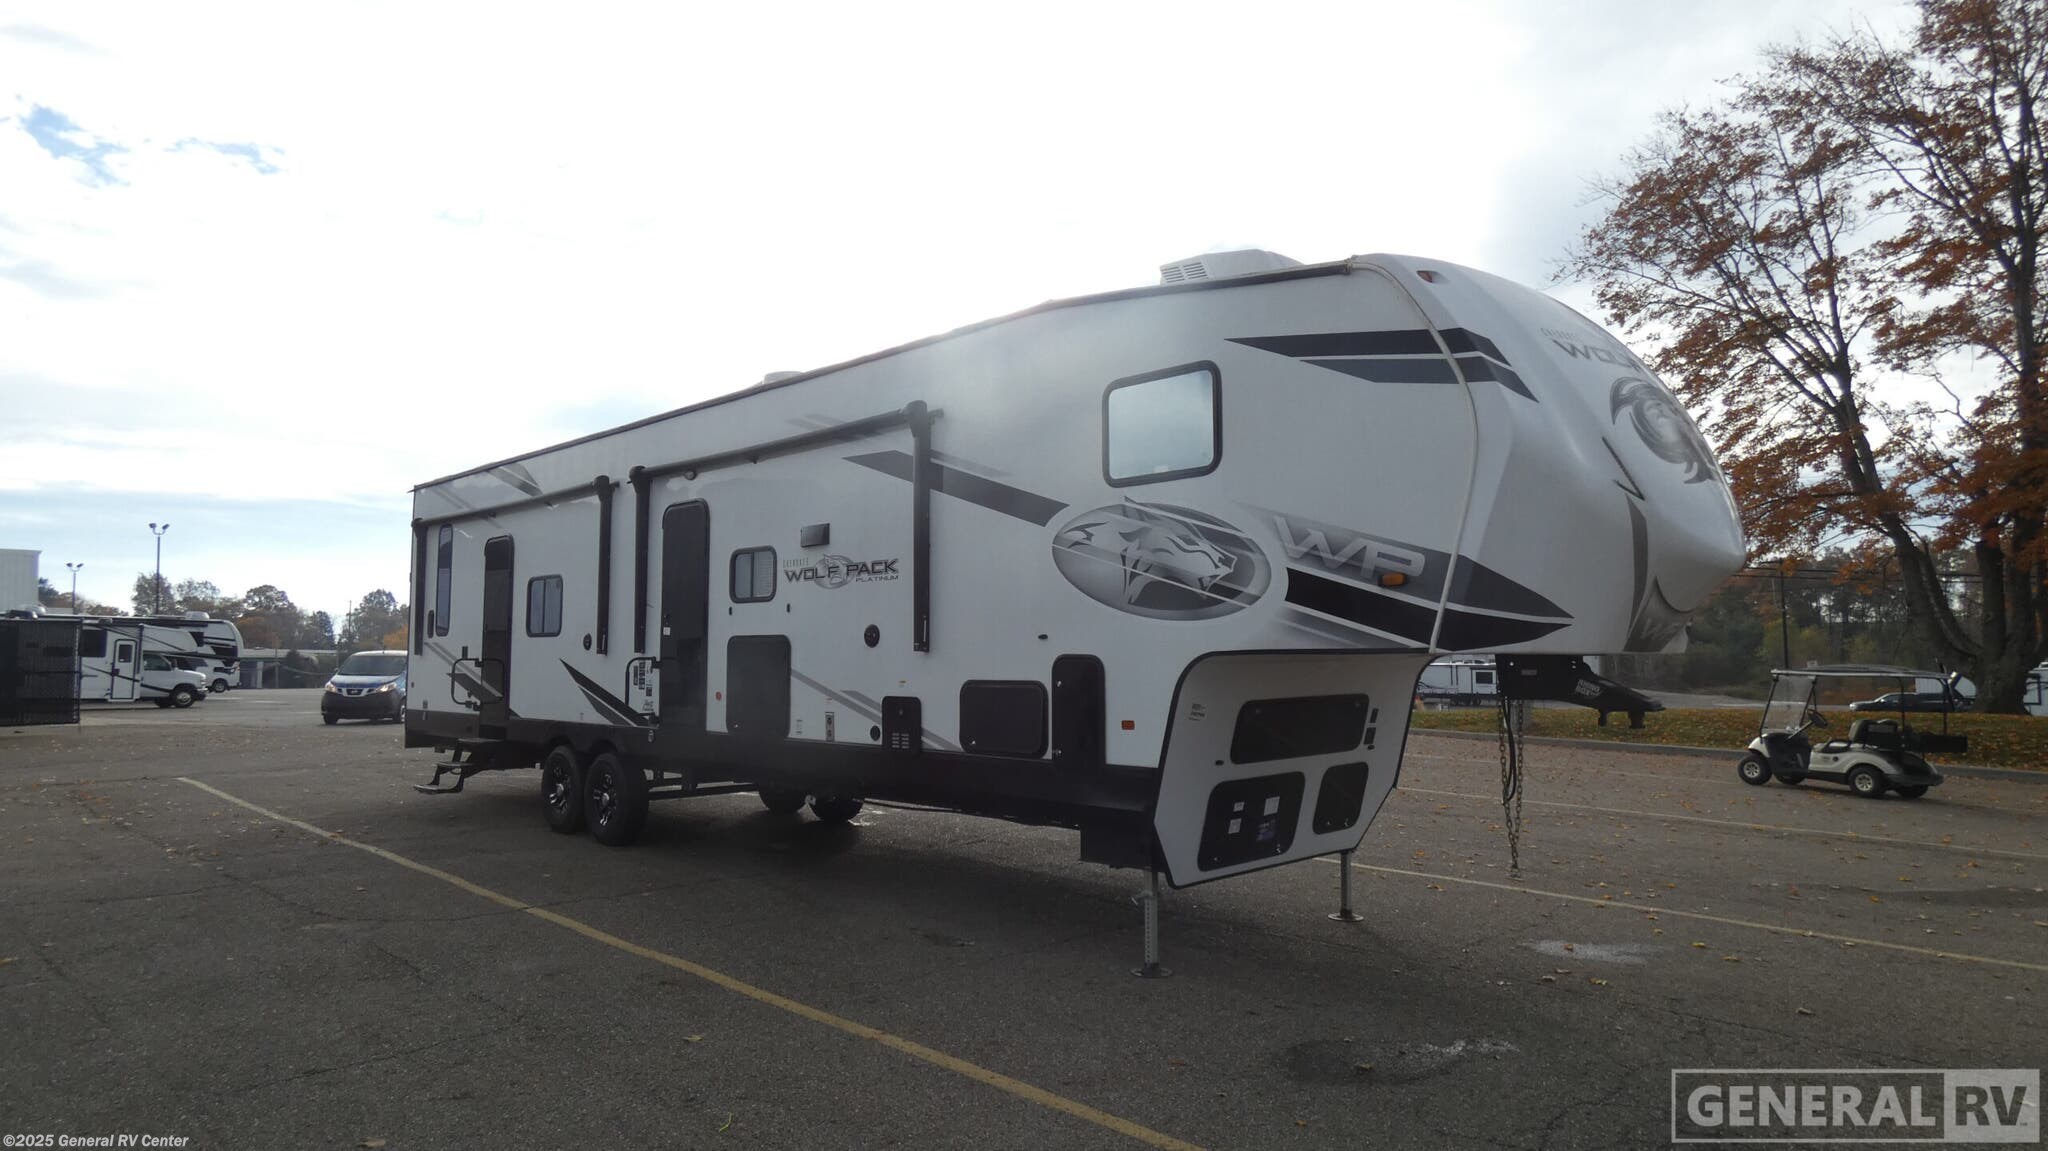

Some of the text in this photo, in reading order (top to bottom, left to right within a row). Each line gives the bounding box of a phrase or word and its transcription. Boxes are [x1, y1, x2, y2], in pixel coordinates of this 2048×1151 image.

[1273, 515, 1425, 578] WP
[785, 558, 899, 582] WOLF PACK
